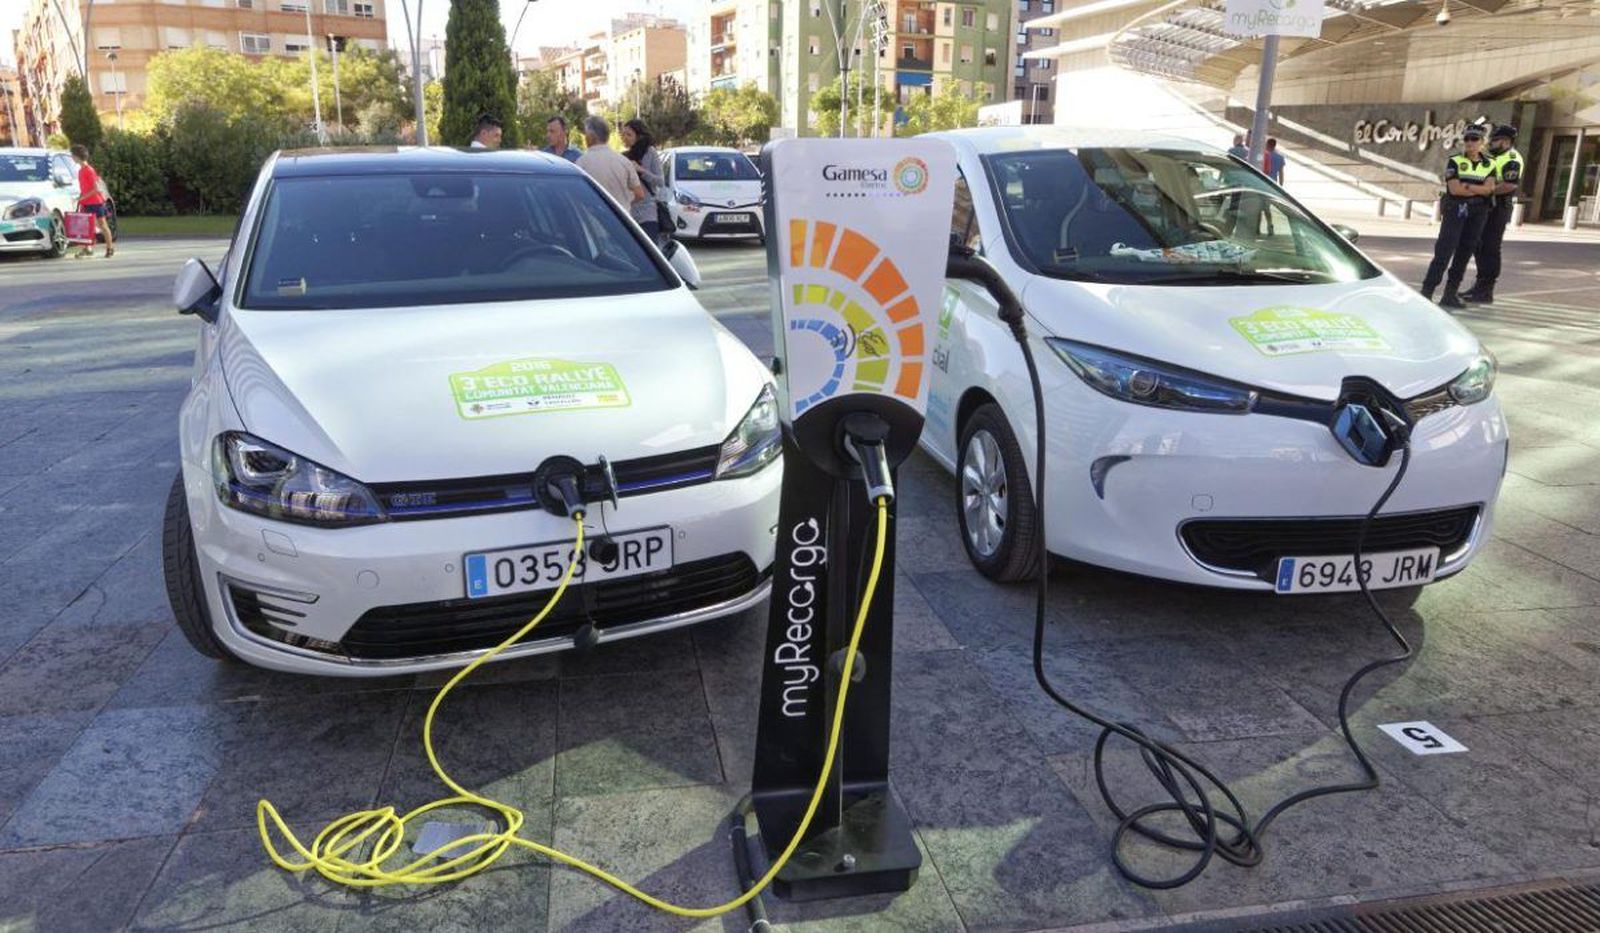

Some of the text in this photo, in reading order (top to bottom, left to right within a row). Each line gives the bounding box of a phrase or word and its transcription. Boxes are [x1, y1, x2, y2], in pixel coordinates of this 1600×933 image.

[1354, 120, 1371, 144] El
[1373, 119, 1418, 144] Corte
[822, 164, 887, 181] Gamesa
[483, 375, 529, 388] ECO
[534, 367, 608, 385] RALLYE
[494, 550, 587, 588] 0358
[1299, 559, 1373, 588] 6948
[1382, 552, 1433, 583] JRM
[1401, 727, 1445, 749] 5
